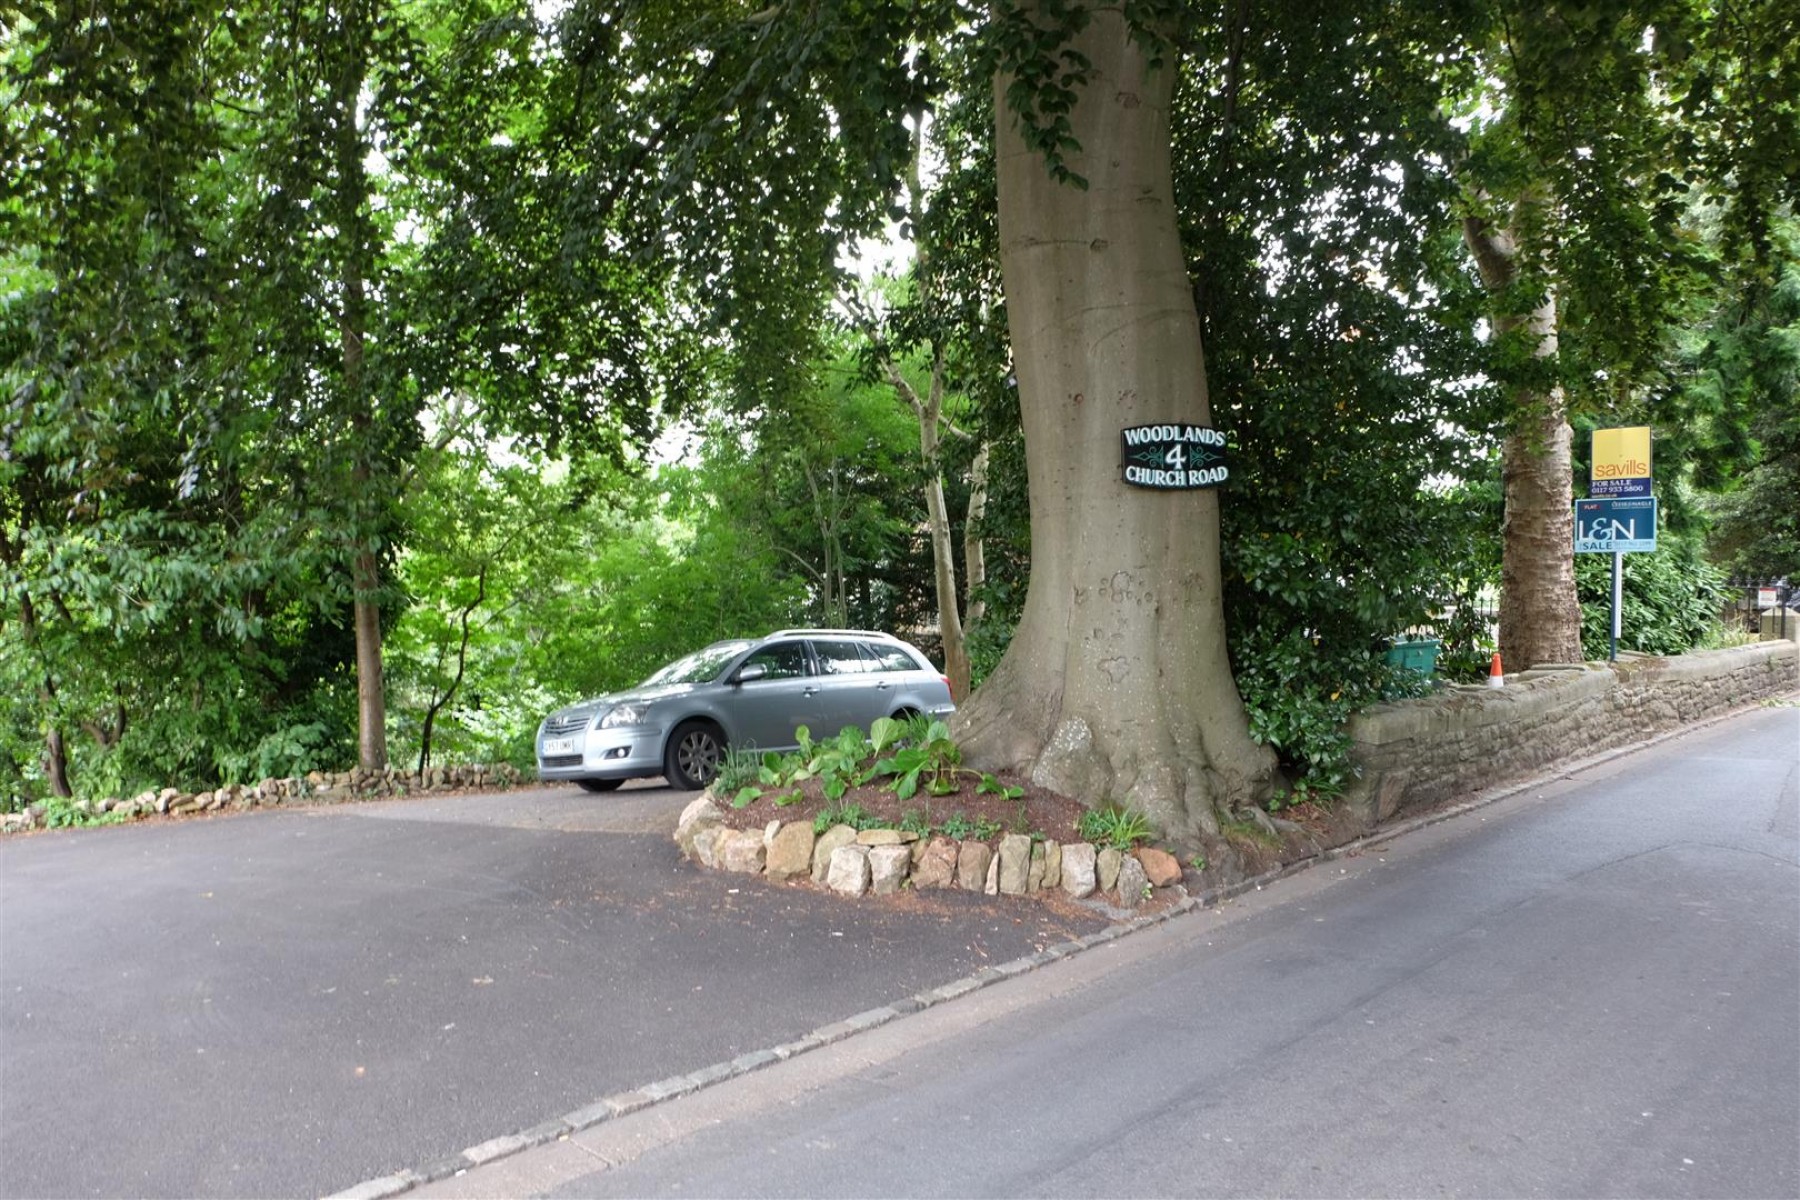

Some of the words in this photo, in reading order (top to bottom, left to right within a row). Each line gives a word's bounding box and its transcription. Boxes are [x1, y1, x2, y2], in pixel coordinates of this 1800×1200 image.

[1124, 425, 1227, 446] WOODLANDS
[1164, 443, 1188, 470] 4
[1125, 465, 1188, 486] CHURCH
[1188, 465, 1229, 486] ROAD
[1594, 460, 1647, 478] savills
[1609, 479, 1632, 487] SALE
[1578, 517, 1635, 541] L&N
[1582, 541, 1612, 550] SALE
